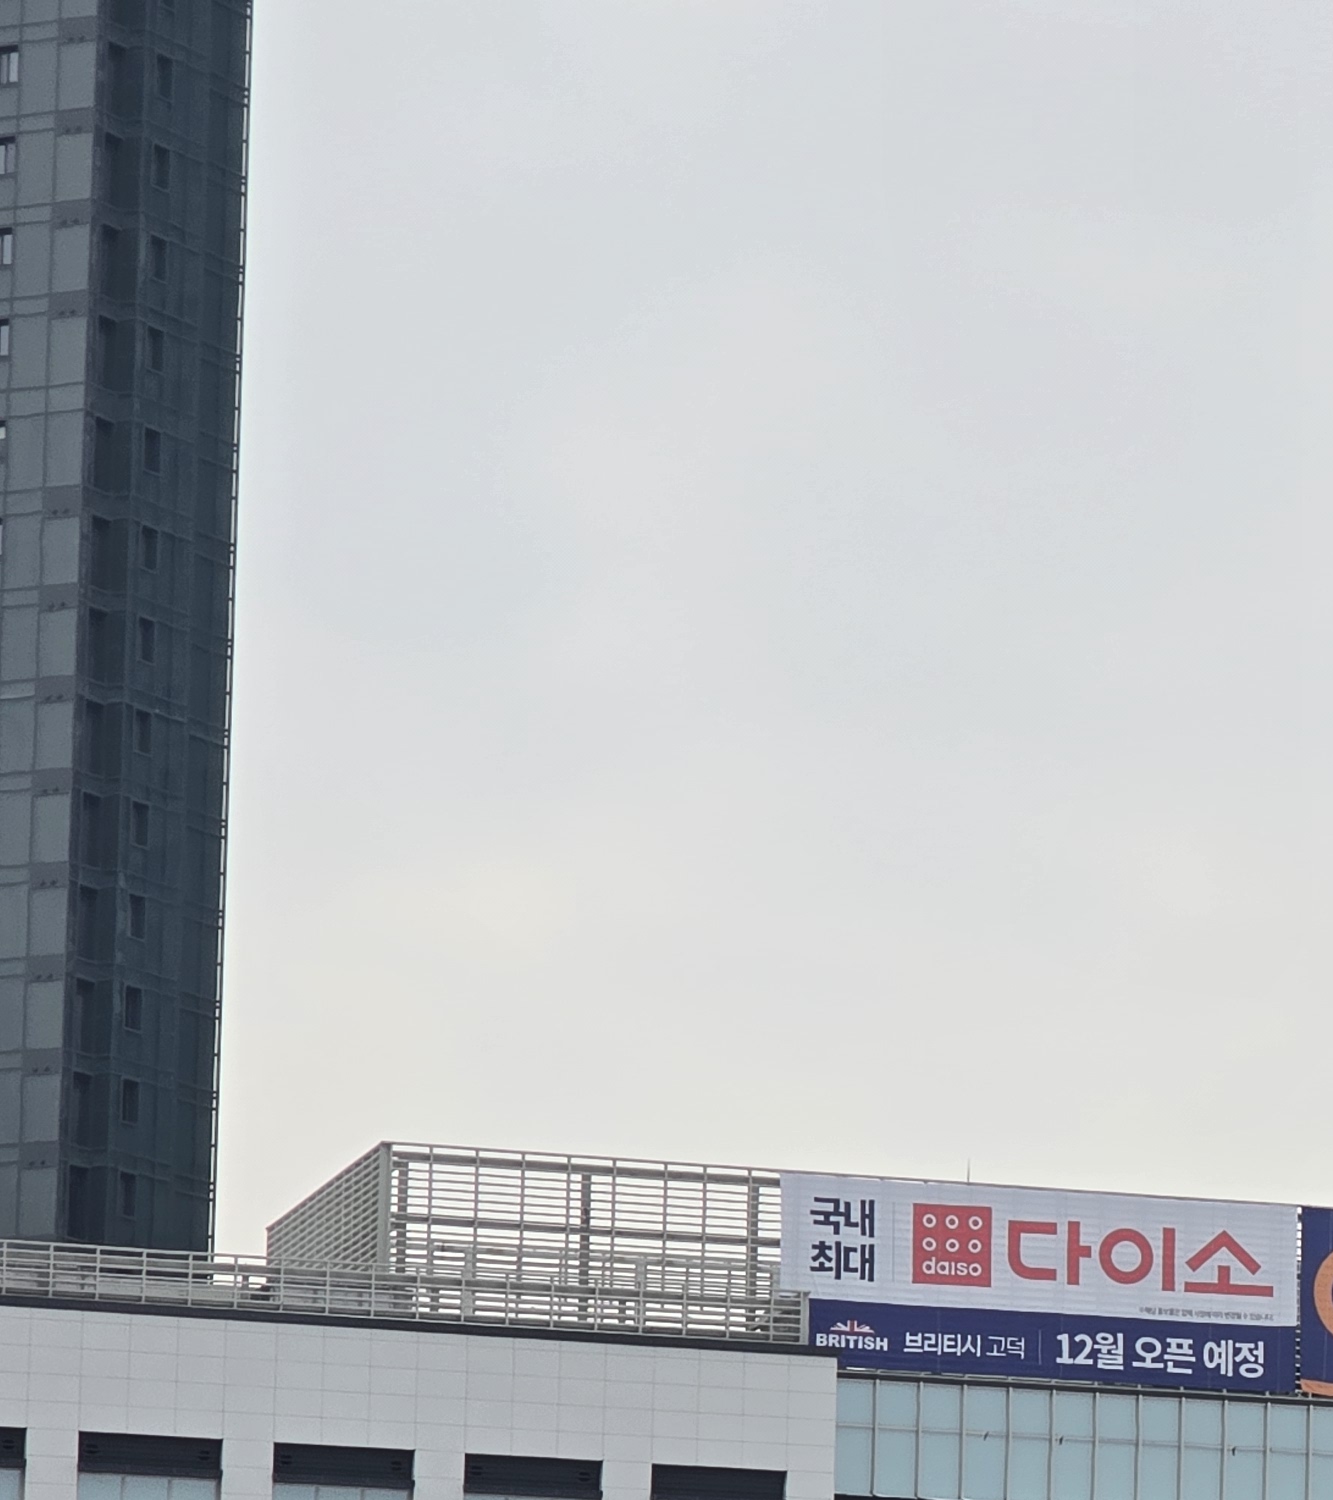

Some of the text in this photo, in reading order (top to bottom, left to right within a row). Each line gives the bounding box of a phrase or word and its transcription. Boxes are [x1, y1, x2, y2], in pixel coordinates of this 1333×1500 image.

[810, 1196, 875, 1238] 국내
[809, 1240, 875, 1282] 최대
[922, 1257, 982, 1277] daiso
[1007, 1219, 1274, 1298] 다이소
[815, 1332, 889, 1352] BRITISH
[903, 1332, 1026, 1360] 브리티시 고덕
[1055, 1332, 1266, 1379] 12월 오픈 예정
